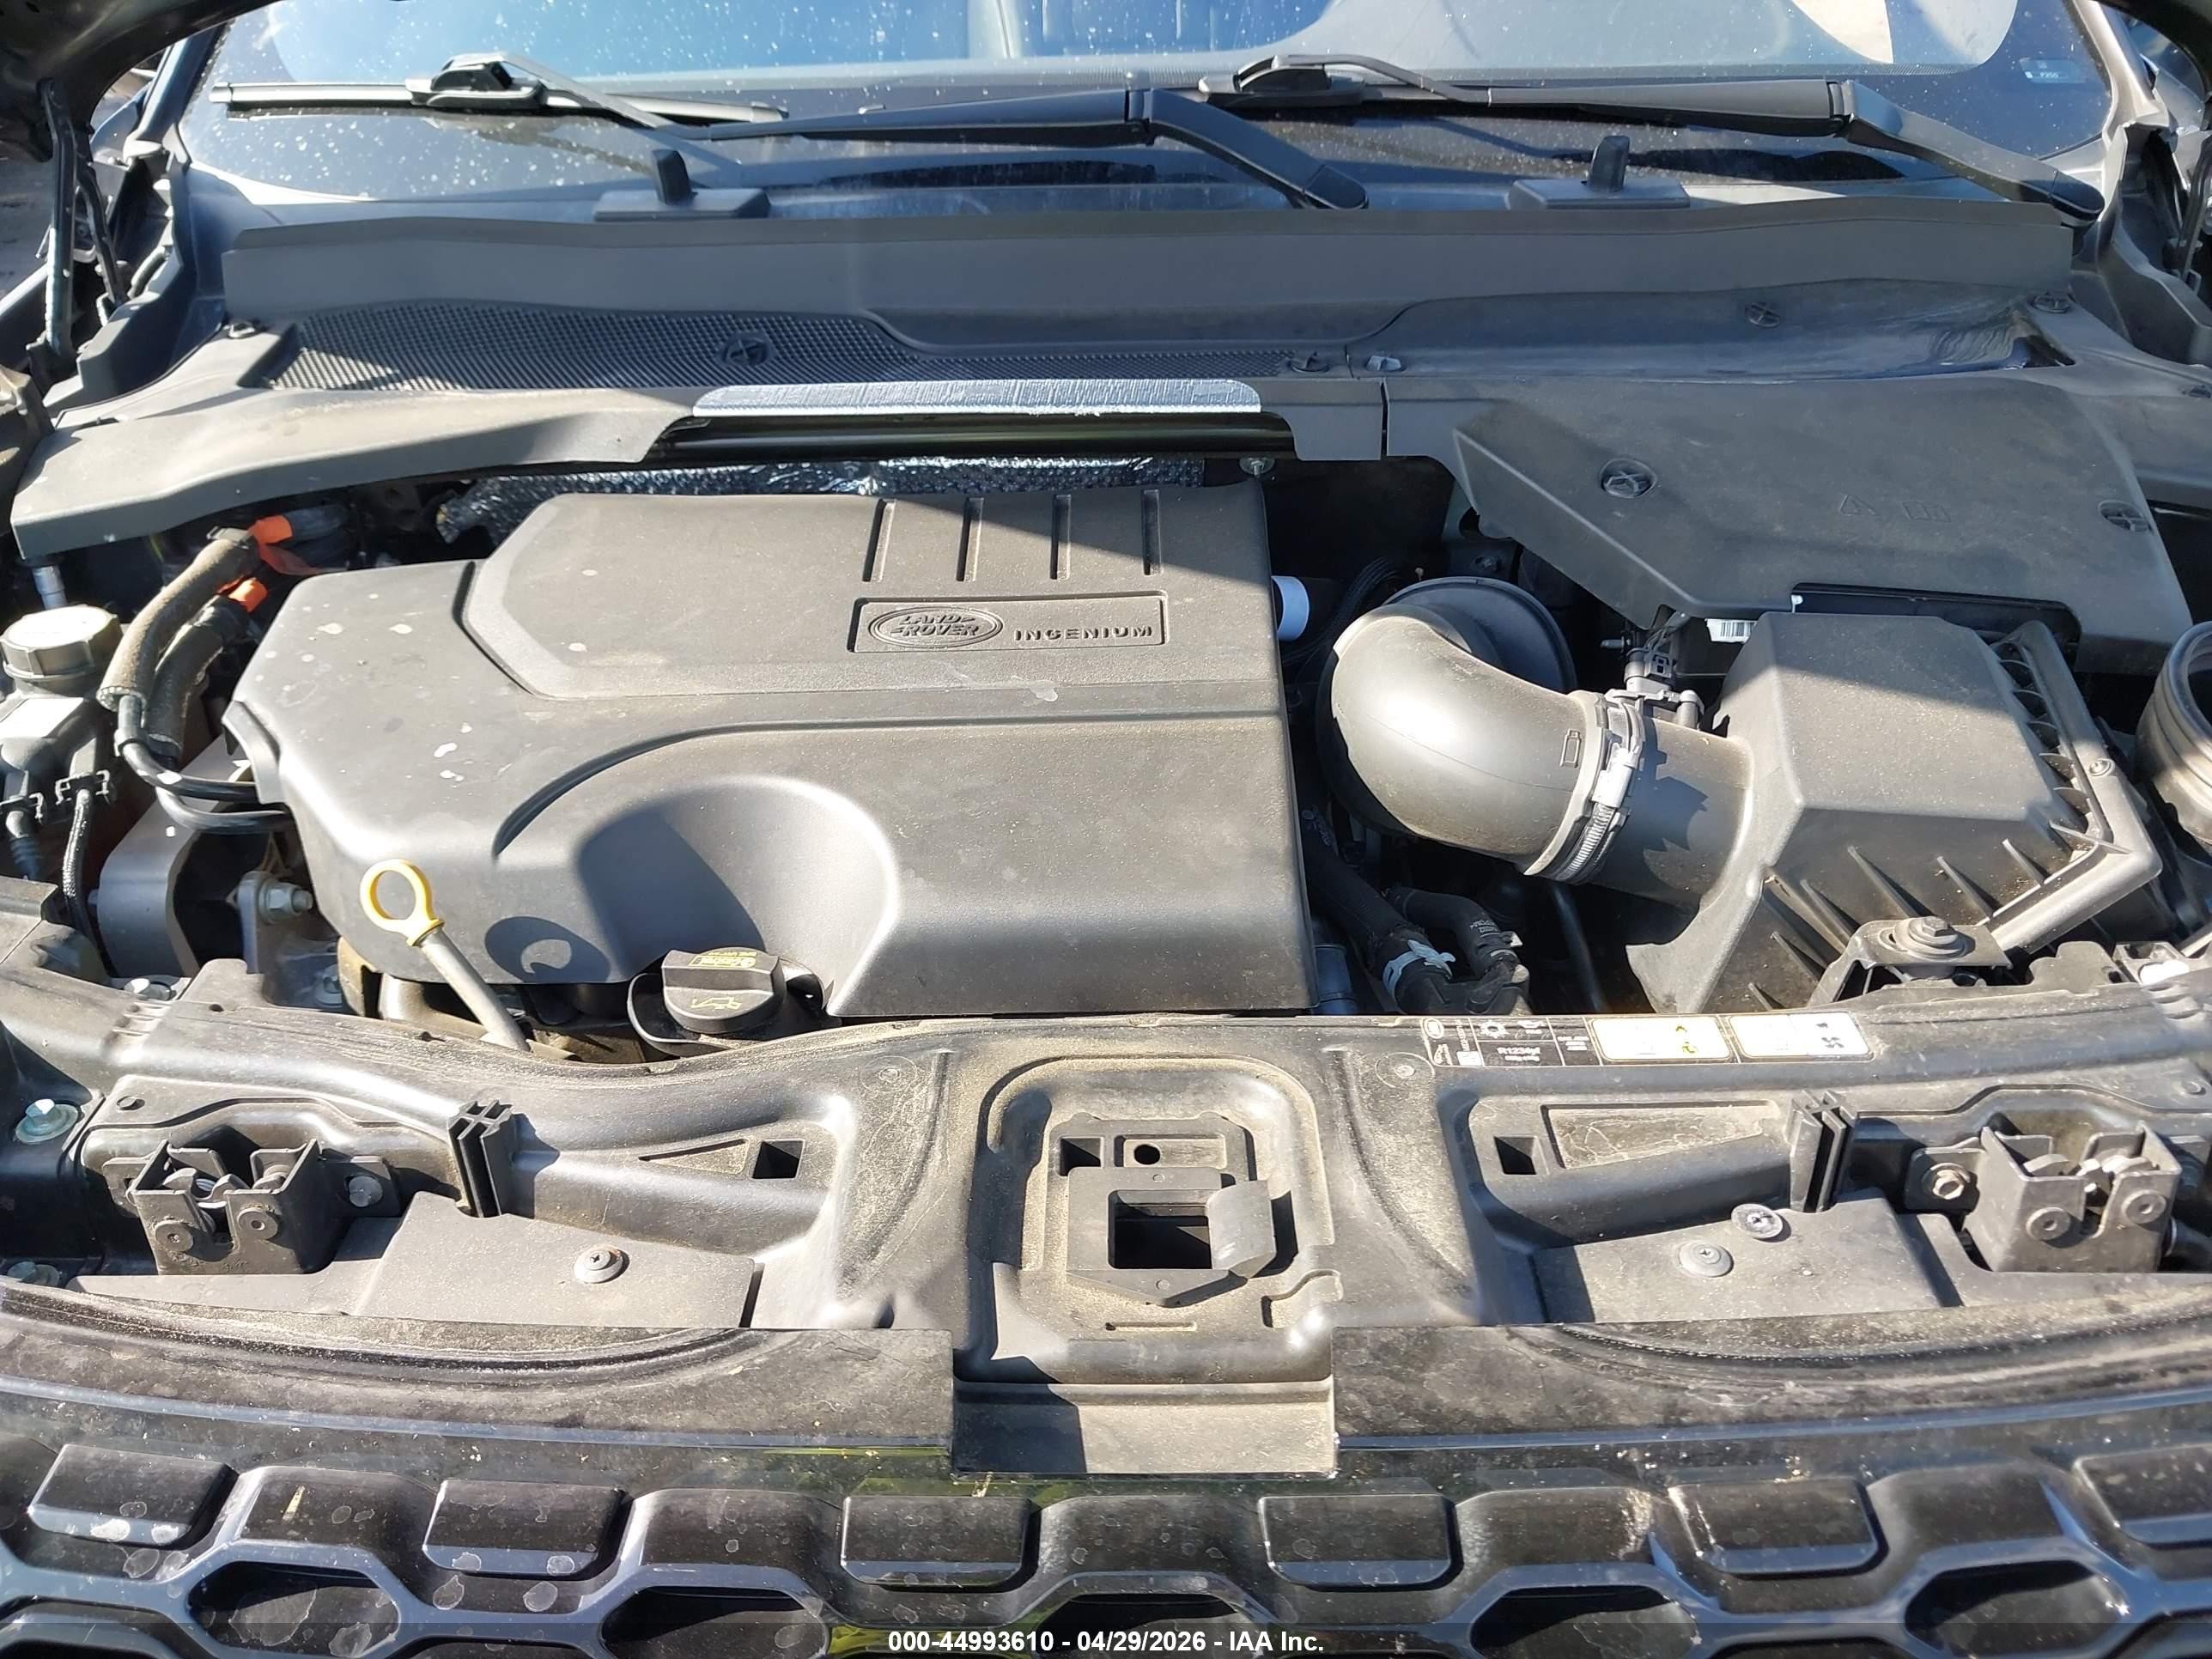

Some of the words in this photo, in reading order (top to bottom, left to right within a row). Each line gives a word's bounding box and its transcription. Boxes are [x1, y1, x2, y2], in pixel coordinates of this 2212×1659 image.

[899, 614, 963, 625] LAND
[902, 623, 980, 636] ROVER
[1014, 626, 1152, 641] INGENIUM
